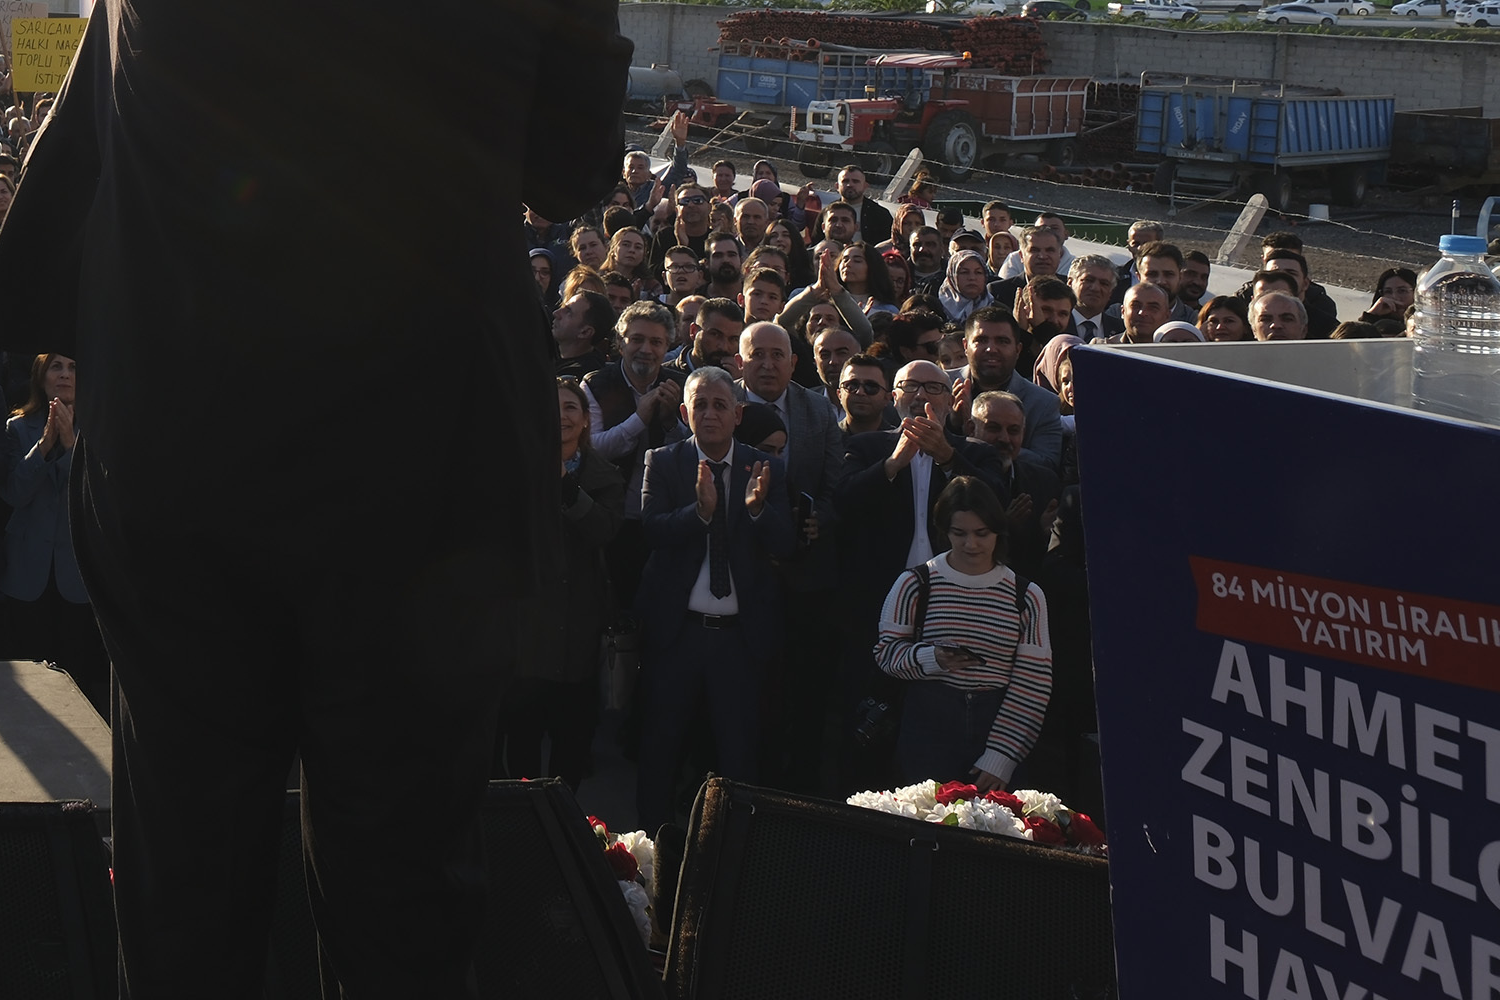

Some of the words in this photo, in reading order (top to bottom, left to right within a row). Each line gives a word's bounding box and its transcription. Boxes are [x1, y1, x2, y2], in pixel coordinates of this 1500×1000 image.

[17, 37, 49, 50] HALKI
[17, 53, 53, 68] TOPLU
[1212, 572, 1245, 601] 84
[1251, 575, 1371, 625] MİLYON
[1293, 616, 1427, 667] YATIRIM
[1210, 639, 1500, 805] AHMET
